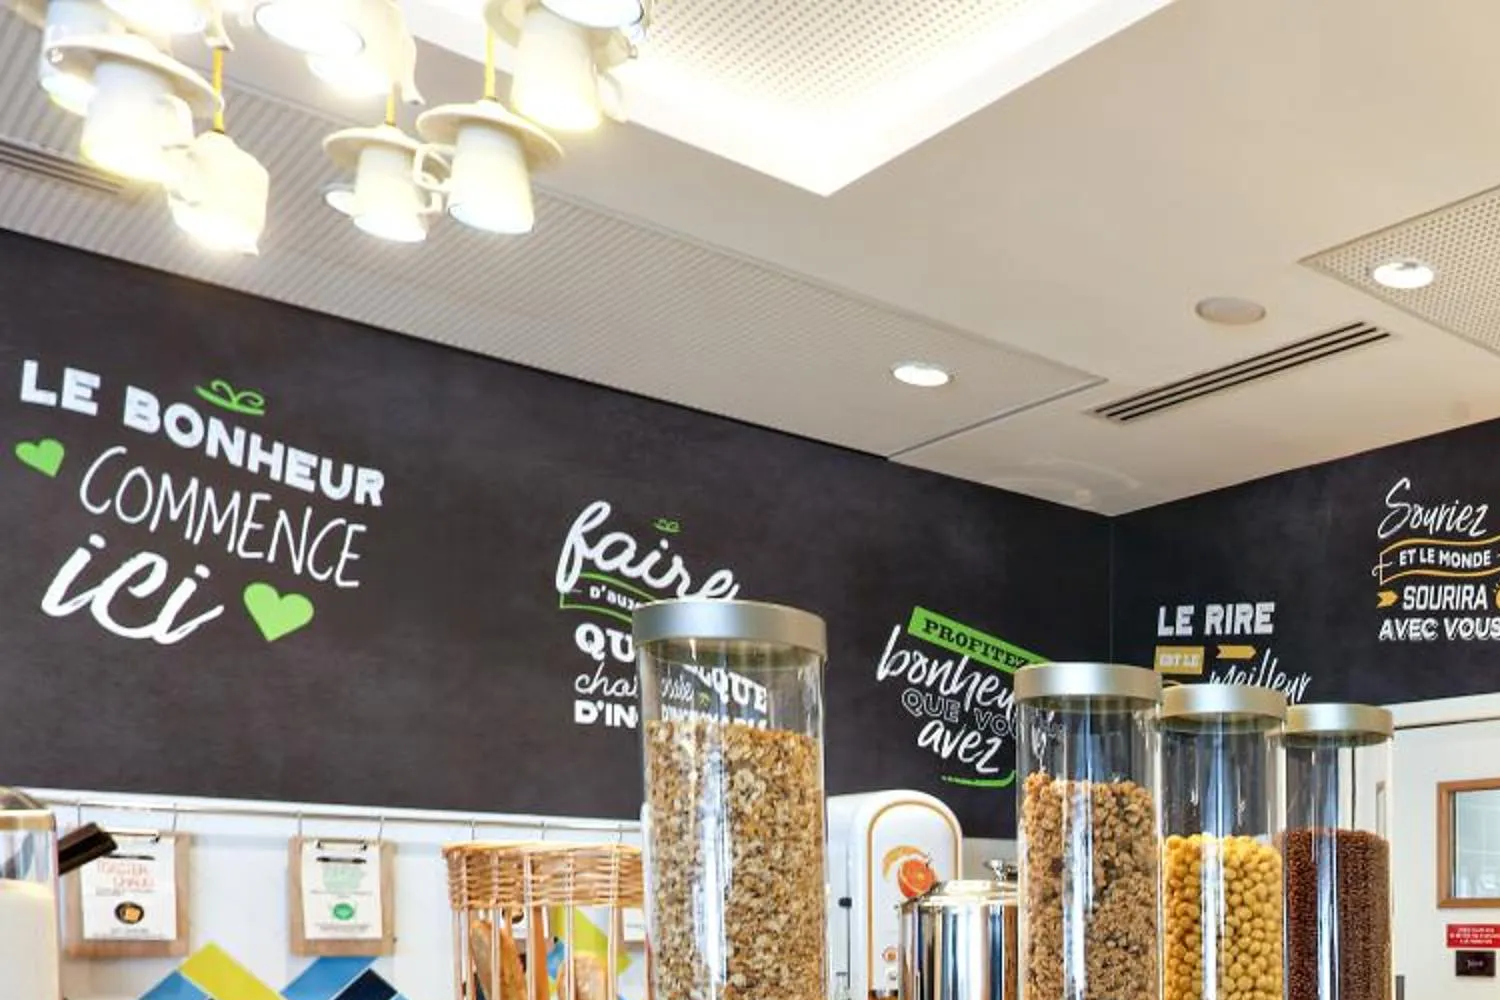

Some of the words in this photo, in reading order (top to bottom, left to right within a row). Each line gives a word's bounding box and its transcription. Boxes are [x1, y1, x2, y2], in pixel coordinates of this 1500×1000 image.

[20, 360, 100, 416] LE
[123, 386, 386, 506] BONHEUR
[79, 446, 367, 588] COMMENCE
[1377, 477, 1489, 539] Souriez
[556, 500, 740, 600] faire
[1400, 549, 1416, 566] ET
[1420, 548, 1435, 564] LE
[1439, 550, 1491, 569] MONDE
[41, 533, 225, 645] ici
[1402, 583, 1489, 611] SOURIRA
[1157, 605, 1195, 637] LE
[1204, 601, 1275, 636] RIRE
[1378, 617, 1439, 642] AVEC
[876, 624, 1016, 720] bonheu
[902, 687, 961, 723] QUE
[917, 719, 1003, 774] avez
